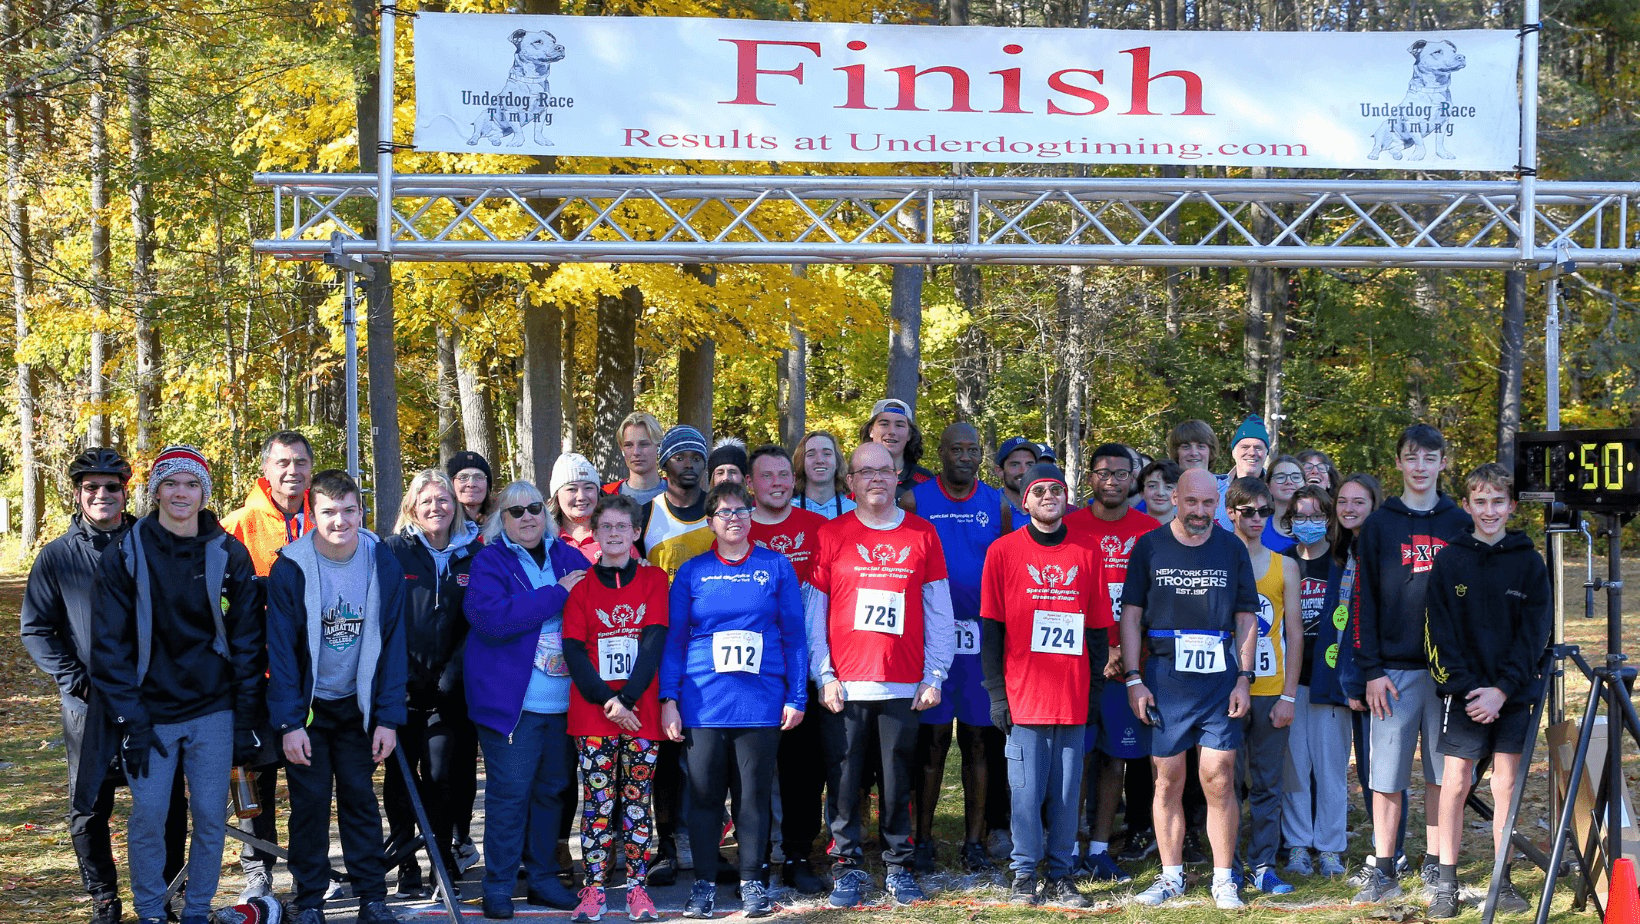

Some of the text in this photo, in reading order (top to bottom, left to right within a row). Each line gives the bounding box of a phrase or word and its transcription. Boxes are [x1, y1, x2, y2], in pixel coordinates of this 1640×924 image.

[717, 38, 1216, 116] Finish
[461, 90, 574, 111] Underdog Race
[1360, 101, 1476, 121] Underdog Race
[487, 108, 553, 126] Timing
[1388, 118, 1454, 137] Timing
[620, 128, 1310, 160] Results at Underdogtiming.com
[1155, 568, 1228, 577] NEW YORK STATE
[1155, 575, 1228, 588] TROOPERS
[864, 604, 896, 628] 725
[1040, 626, 1075, 649] 724
[606, 652, 631, 675] 730
[721, 645, 756, 667] 712
[1183, 649, 1216, 670] 707
